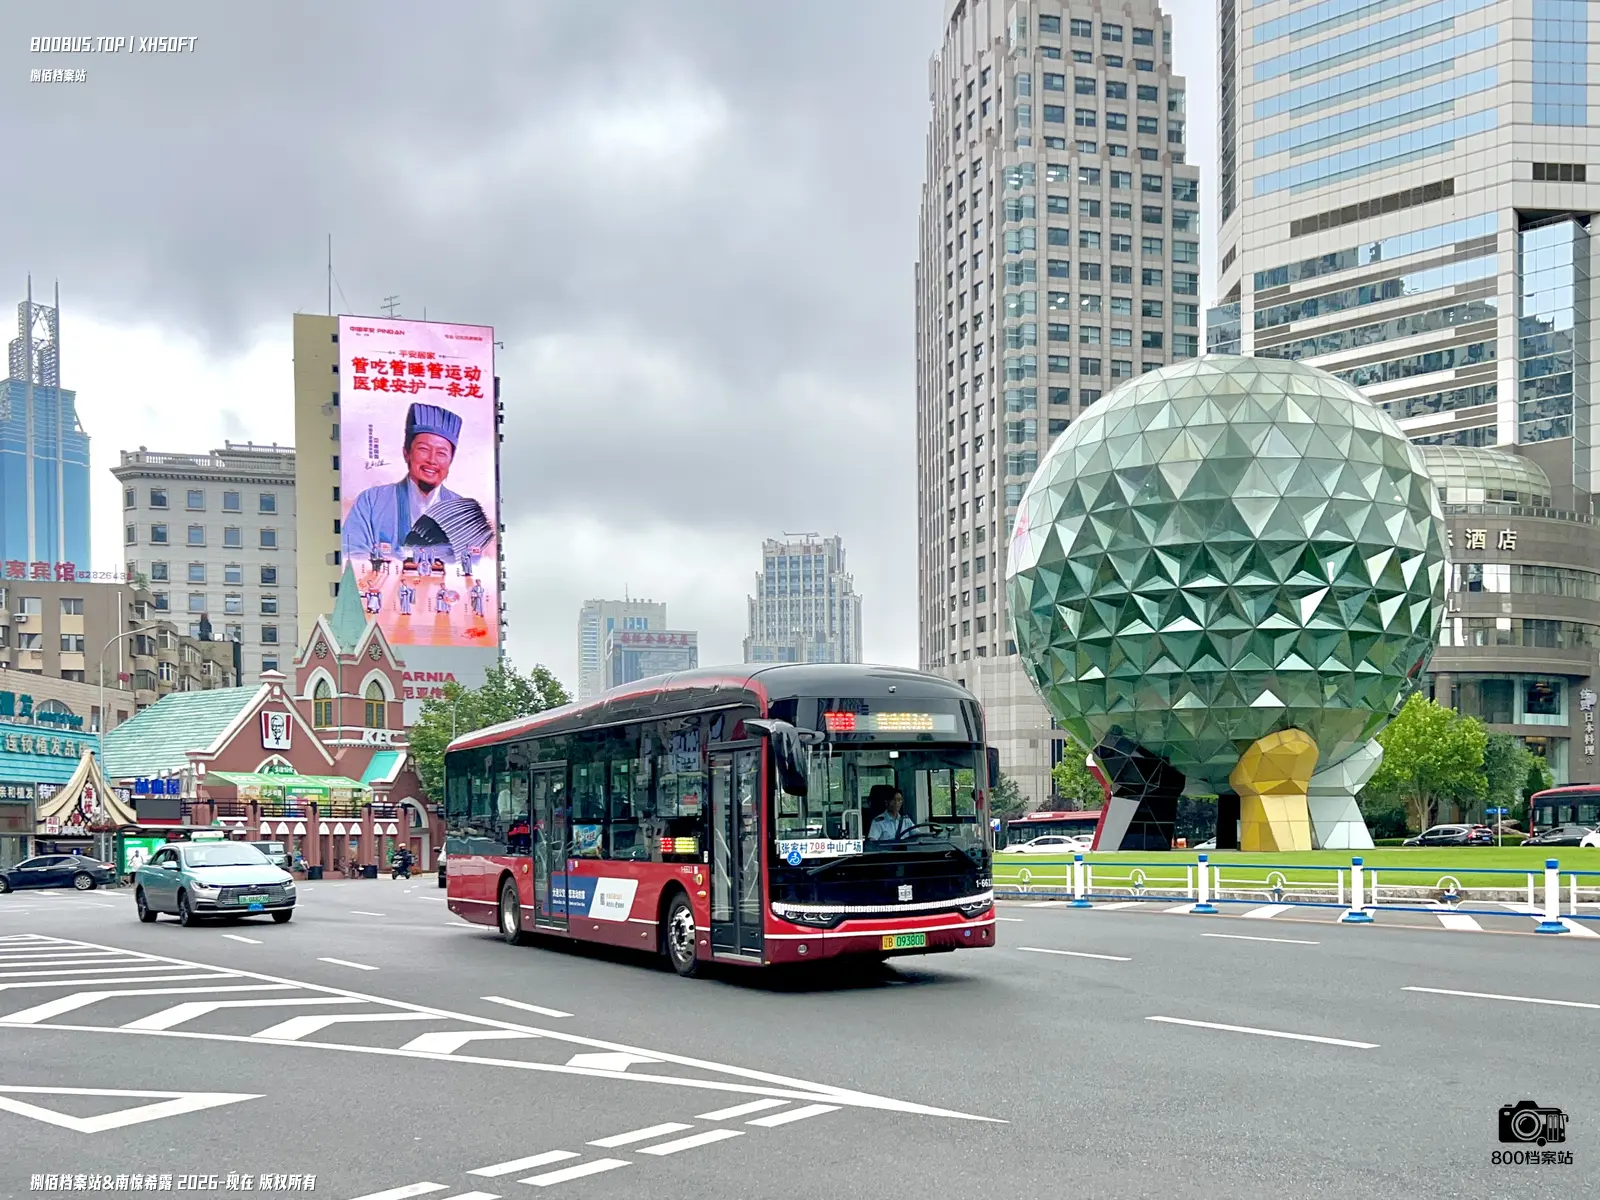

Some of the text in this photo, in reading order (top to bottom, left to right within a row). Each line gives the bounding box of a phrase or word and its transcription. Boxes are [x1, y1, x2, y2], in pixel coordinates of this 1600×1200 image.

[351, 356, 482, 382] 管吃管睡管运动
[353, 376, 484, 399] 医健安护一条龙
[0, 560, 76, 582] 家宾馆
[362, 731, 398, 745] KFC
[1584, 712, 1595, 755] 日本料理
[809, 842, 825, 850] 708
[827, 841, 862, 853] 中山广场
[896, 935, 925, 947] 093800
